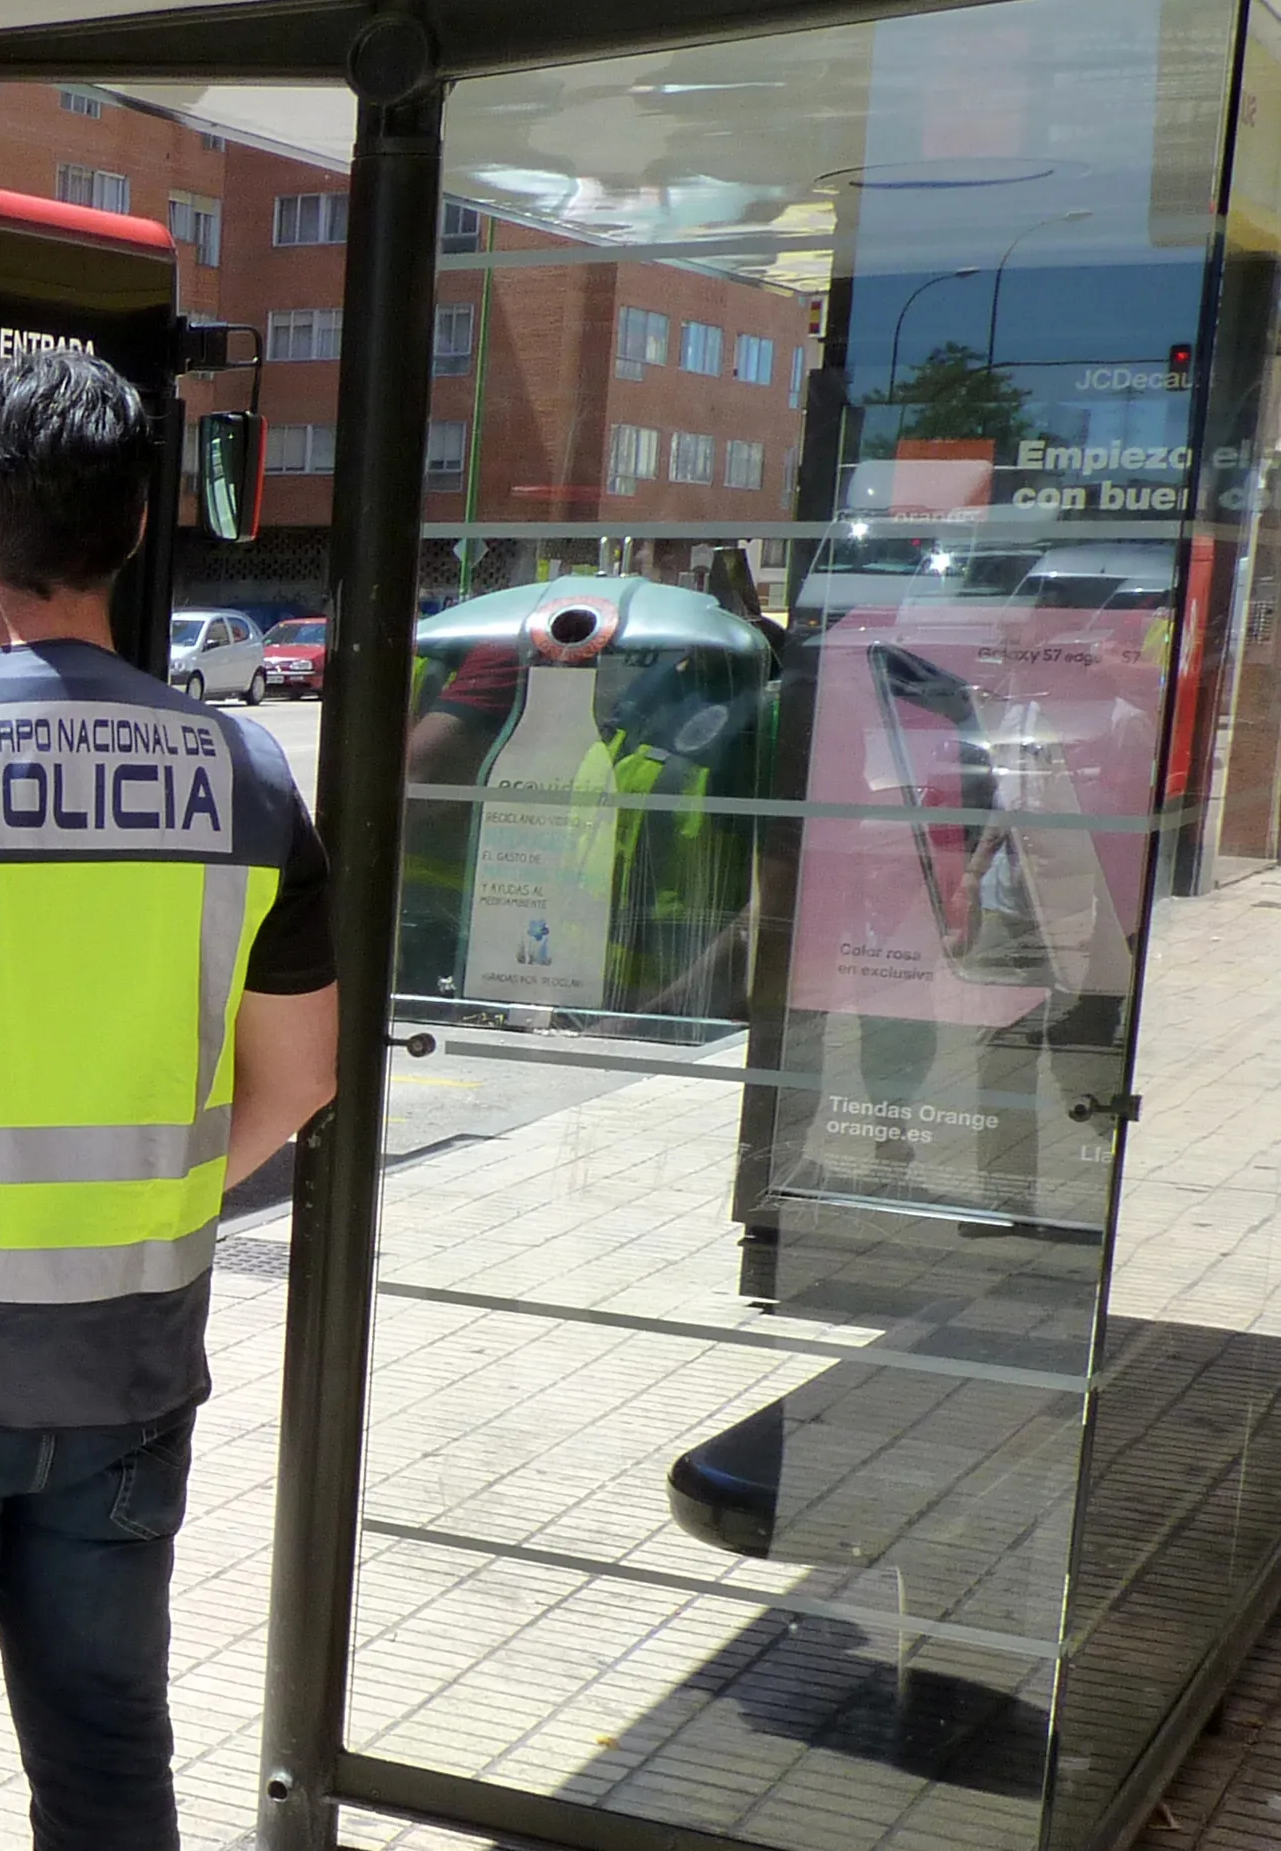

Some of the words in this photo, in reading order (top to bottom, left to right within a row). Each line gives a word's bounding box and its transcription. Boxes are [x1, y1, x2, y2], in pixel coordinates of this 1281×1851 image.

[1075, 368, 1200, 390] JCDecau
[1013, 486, 1086, 511] con
[58, 717, 179, 757] NACIONAL
[181, 725, 217, 757] DE
[496, 852, 527, 863] GASTO
[490, 884, 530, 896] AYUDAS
[838, 964, 858, 976] en
[829, 1095, 912, 1120] Tiendas
[919, 1104, 999, 1131] Orange
[826, 1119, 933, 1144] orange.es
